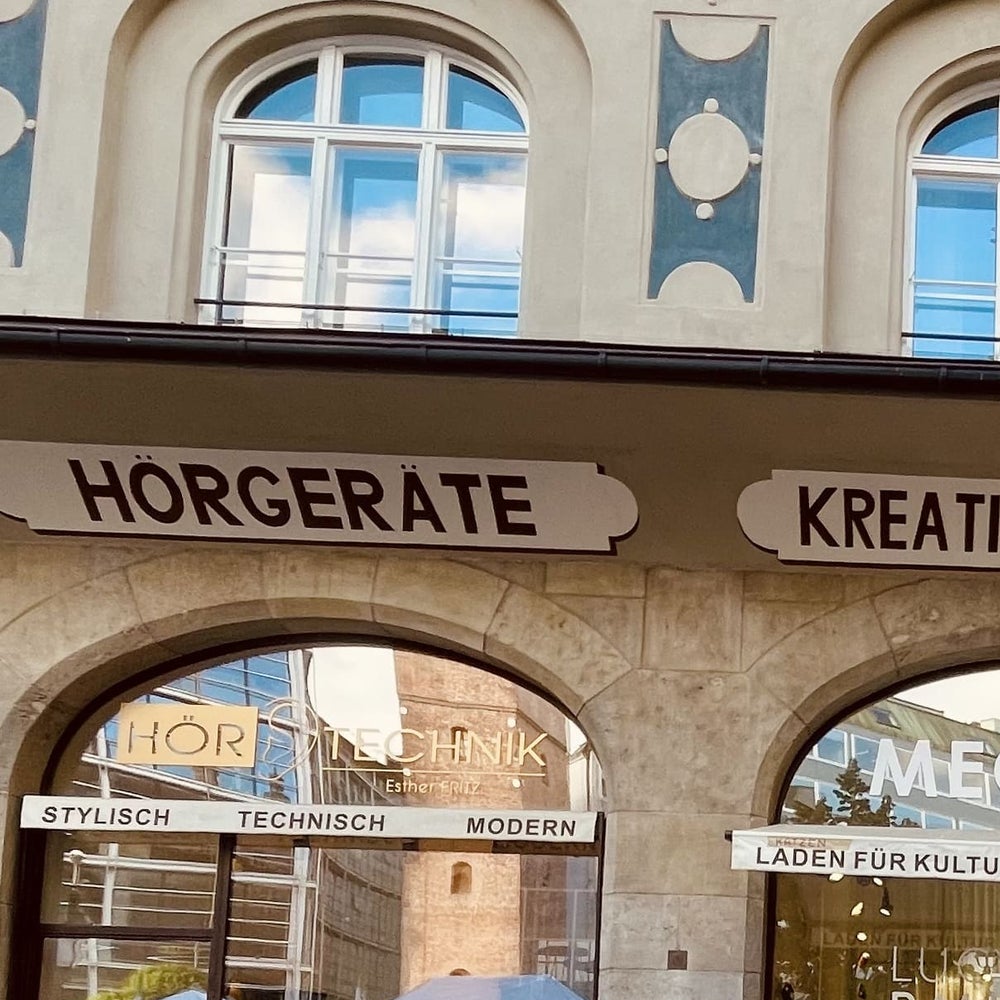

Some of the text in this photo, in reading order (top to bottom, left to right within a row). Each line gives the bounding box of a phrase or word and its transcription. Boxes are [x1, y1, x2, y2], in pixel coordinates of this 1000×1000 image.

[68, 455, 537, 536] HÖRGERÄTE
[128, 715, 548, 767] HÖR TECHNIK
[386, 779, 435, 794] Esther
[42, 805, 577, 837] STYLISCH TECHNISCH MODERN
[756, 847, 845, 869] LADEN
[853, 850, 906, 871] FÜR
